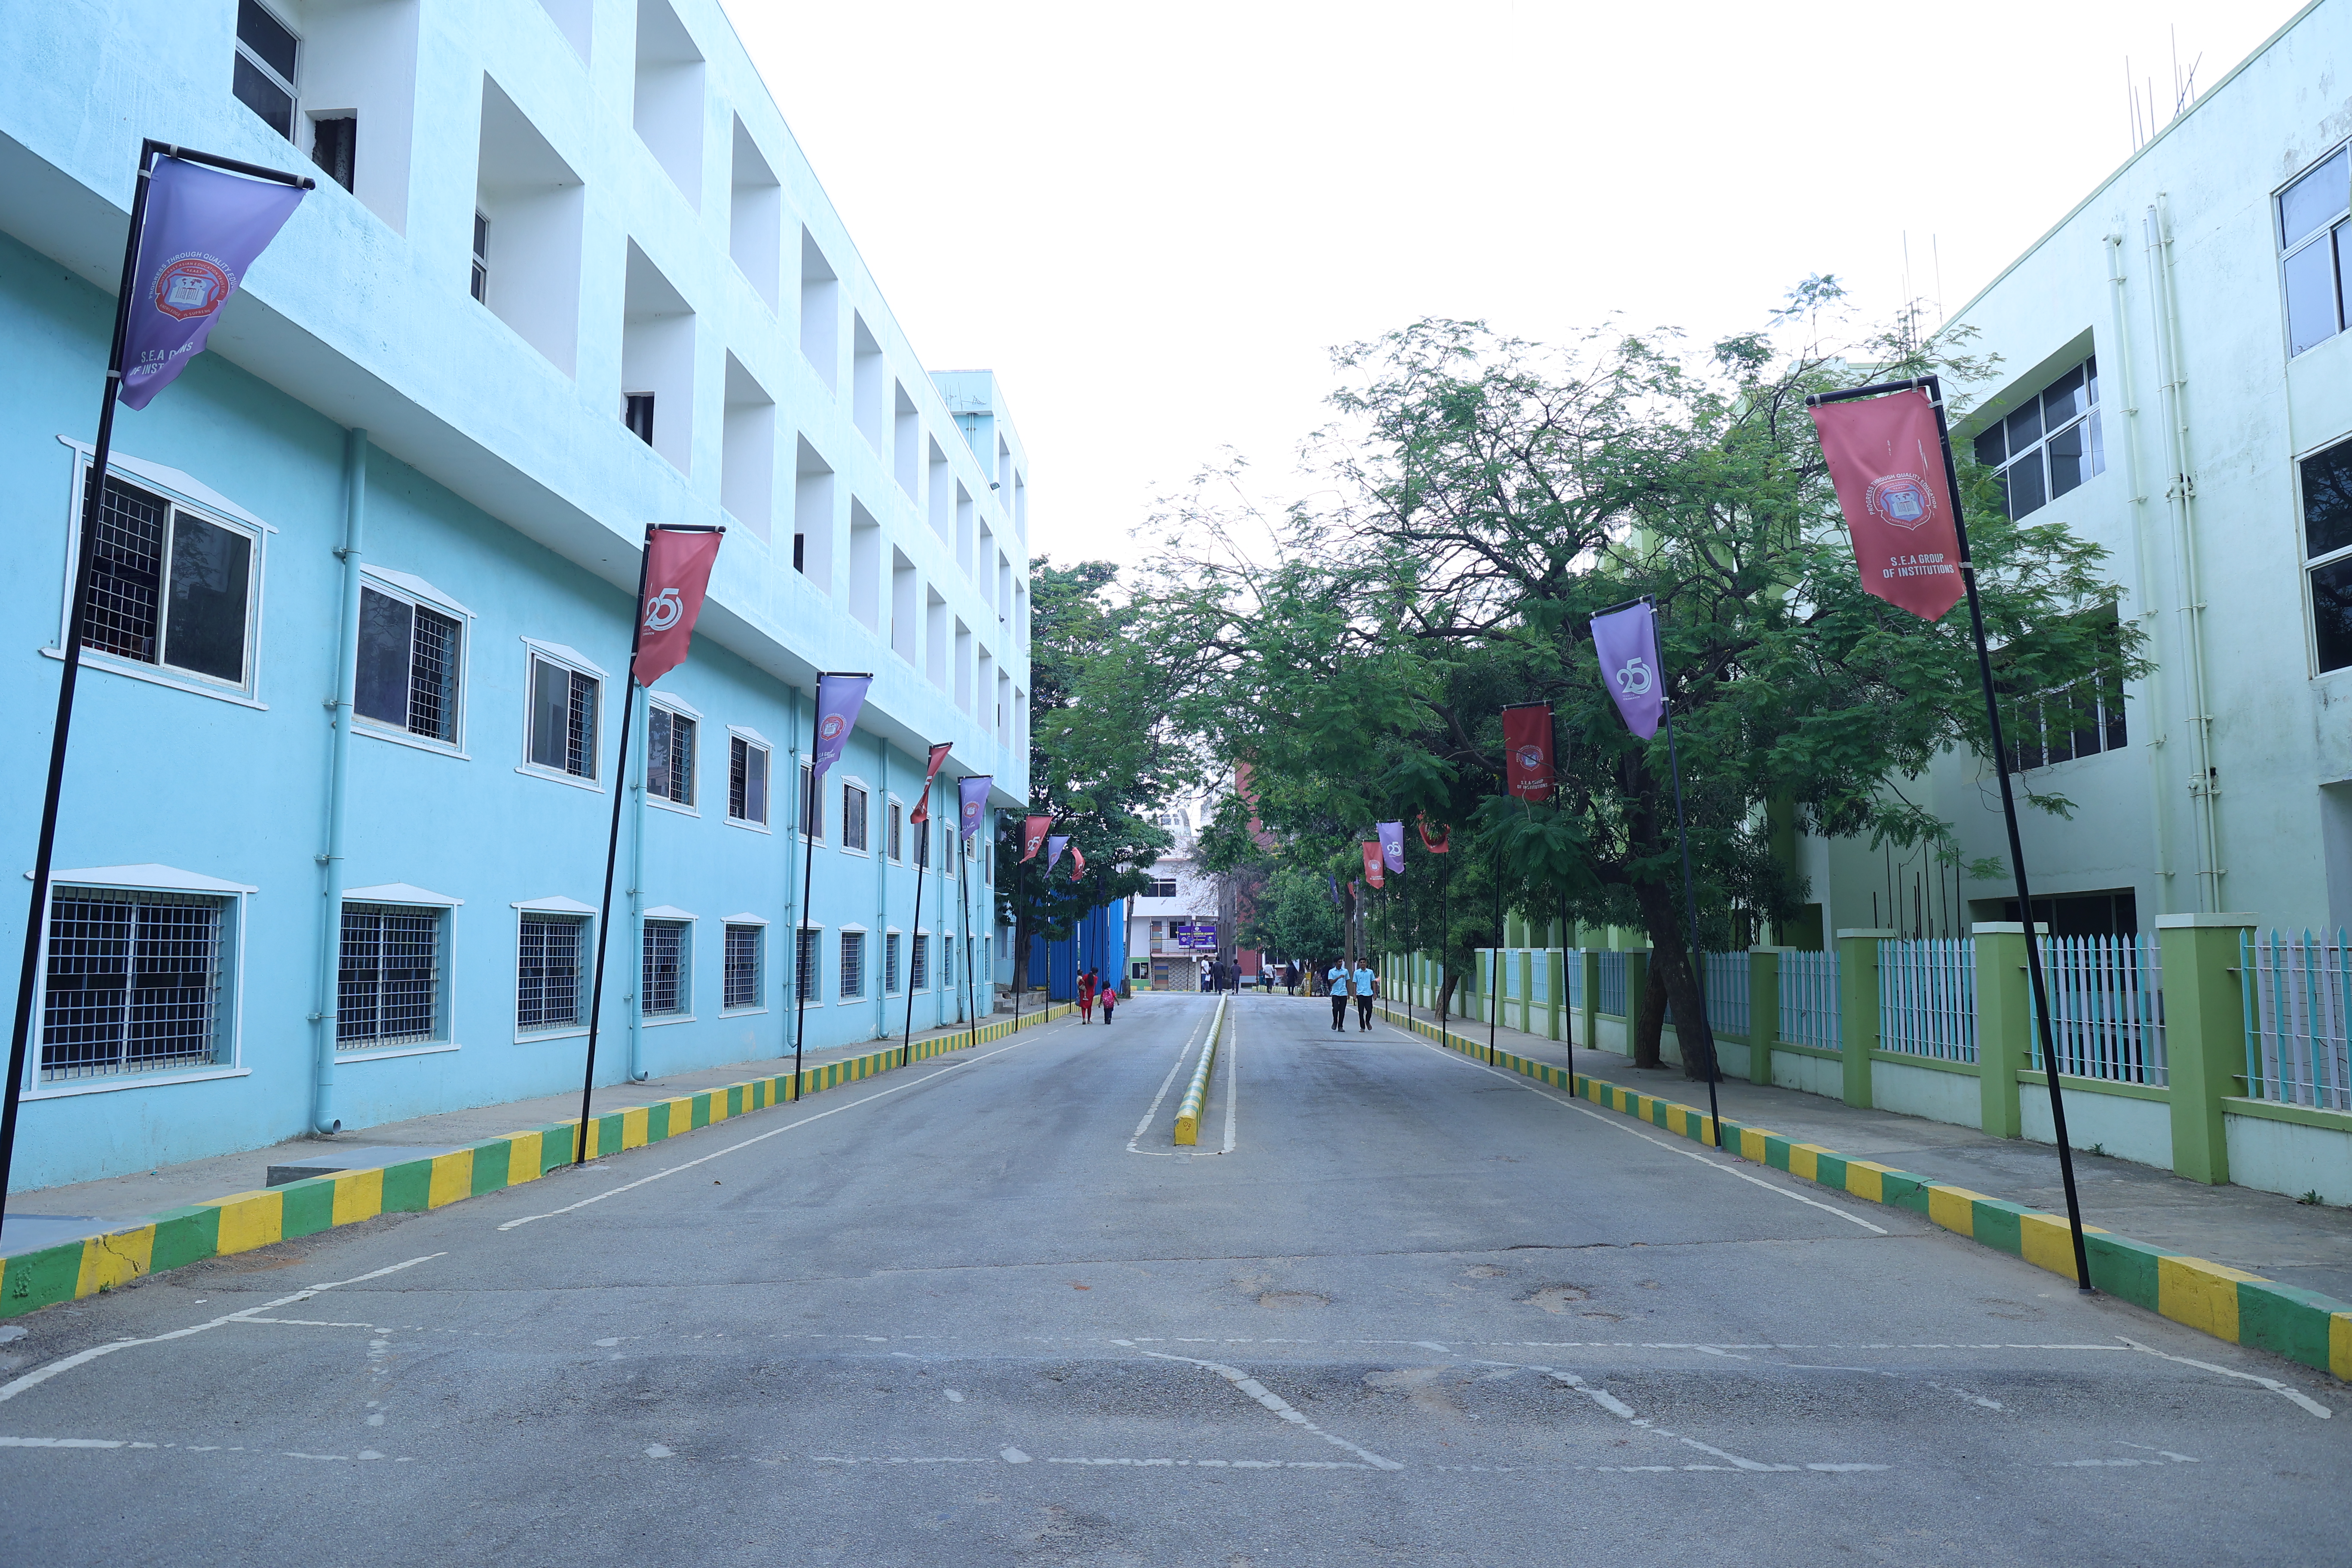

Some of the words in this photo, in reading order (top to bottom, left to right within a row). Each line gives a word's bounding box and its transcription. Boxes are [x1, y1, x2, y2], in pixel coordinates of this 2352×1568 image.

[149, 263, 166, 299] PROGRESS
[166, 251, 202, 264] THROUGH
[203, 253, 231, 272] QUALITY
[159, 273, 167, 288] SOUTH
[167, 265, 178, 275] EAST
[194, 262, 218, 275] EDUCATION
[160, 304, 181, 317] KNOWLEDGE
[141, 349, 164, 363] S.E.A
[1865, 486, 1876, 515] PROGRESS
[1871, 475, 1896, 487] THROUGH
[1920, 479, 1937, 509] EDUCATION
[1889, 518, 1911, 527] KNOWLEDGE
[1916, 515, 1928, 524] SUPREME
[1890, 555, 1917, 567] S.E.A
[1918, 553, 1944, 564] GROUP
[1883, 568, 1895, 579] OF
[1898, 564, 1955, 577] INSTITUTIONS
[644, 588, 680, 626] 25
[1616, 657, 1651, 693] 25
[1387, 841, 1401, 855] 25
